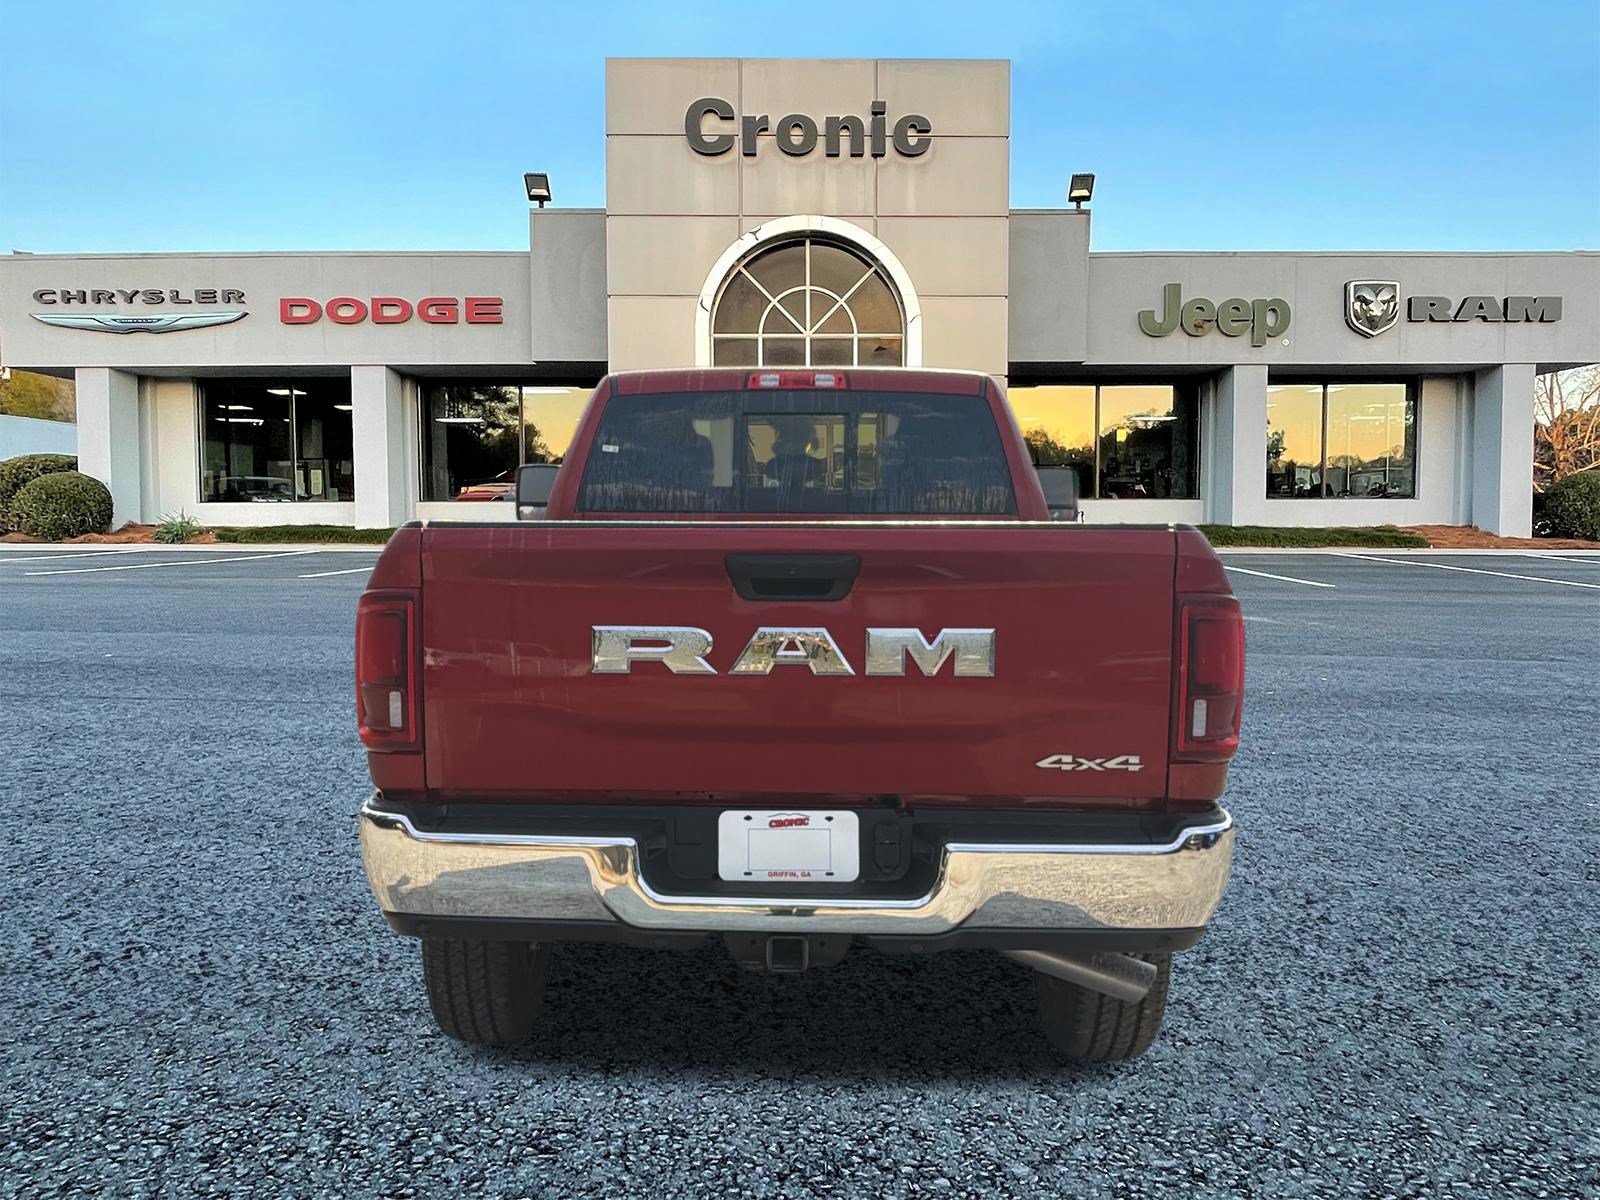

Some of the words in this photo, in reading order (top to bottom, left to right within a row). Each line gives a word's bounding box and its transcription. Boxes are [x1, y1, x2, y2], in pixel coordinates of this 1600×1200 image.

[684, 97, 932, 158] Cronic
[32, 288, 246, 305] CHRYSLER
[1408, 296, 1563, 323] RAM
[279, 297, 504, 325] DODGE
[1138, 283, 1291, 347] Jeep
[591, 625, 996, 678] RAM
[1035, 754, 1144, 772] 4x4
[767, 871, 799, 879] GRIFFIN,
